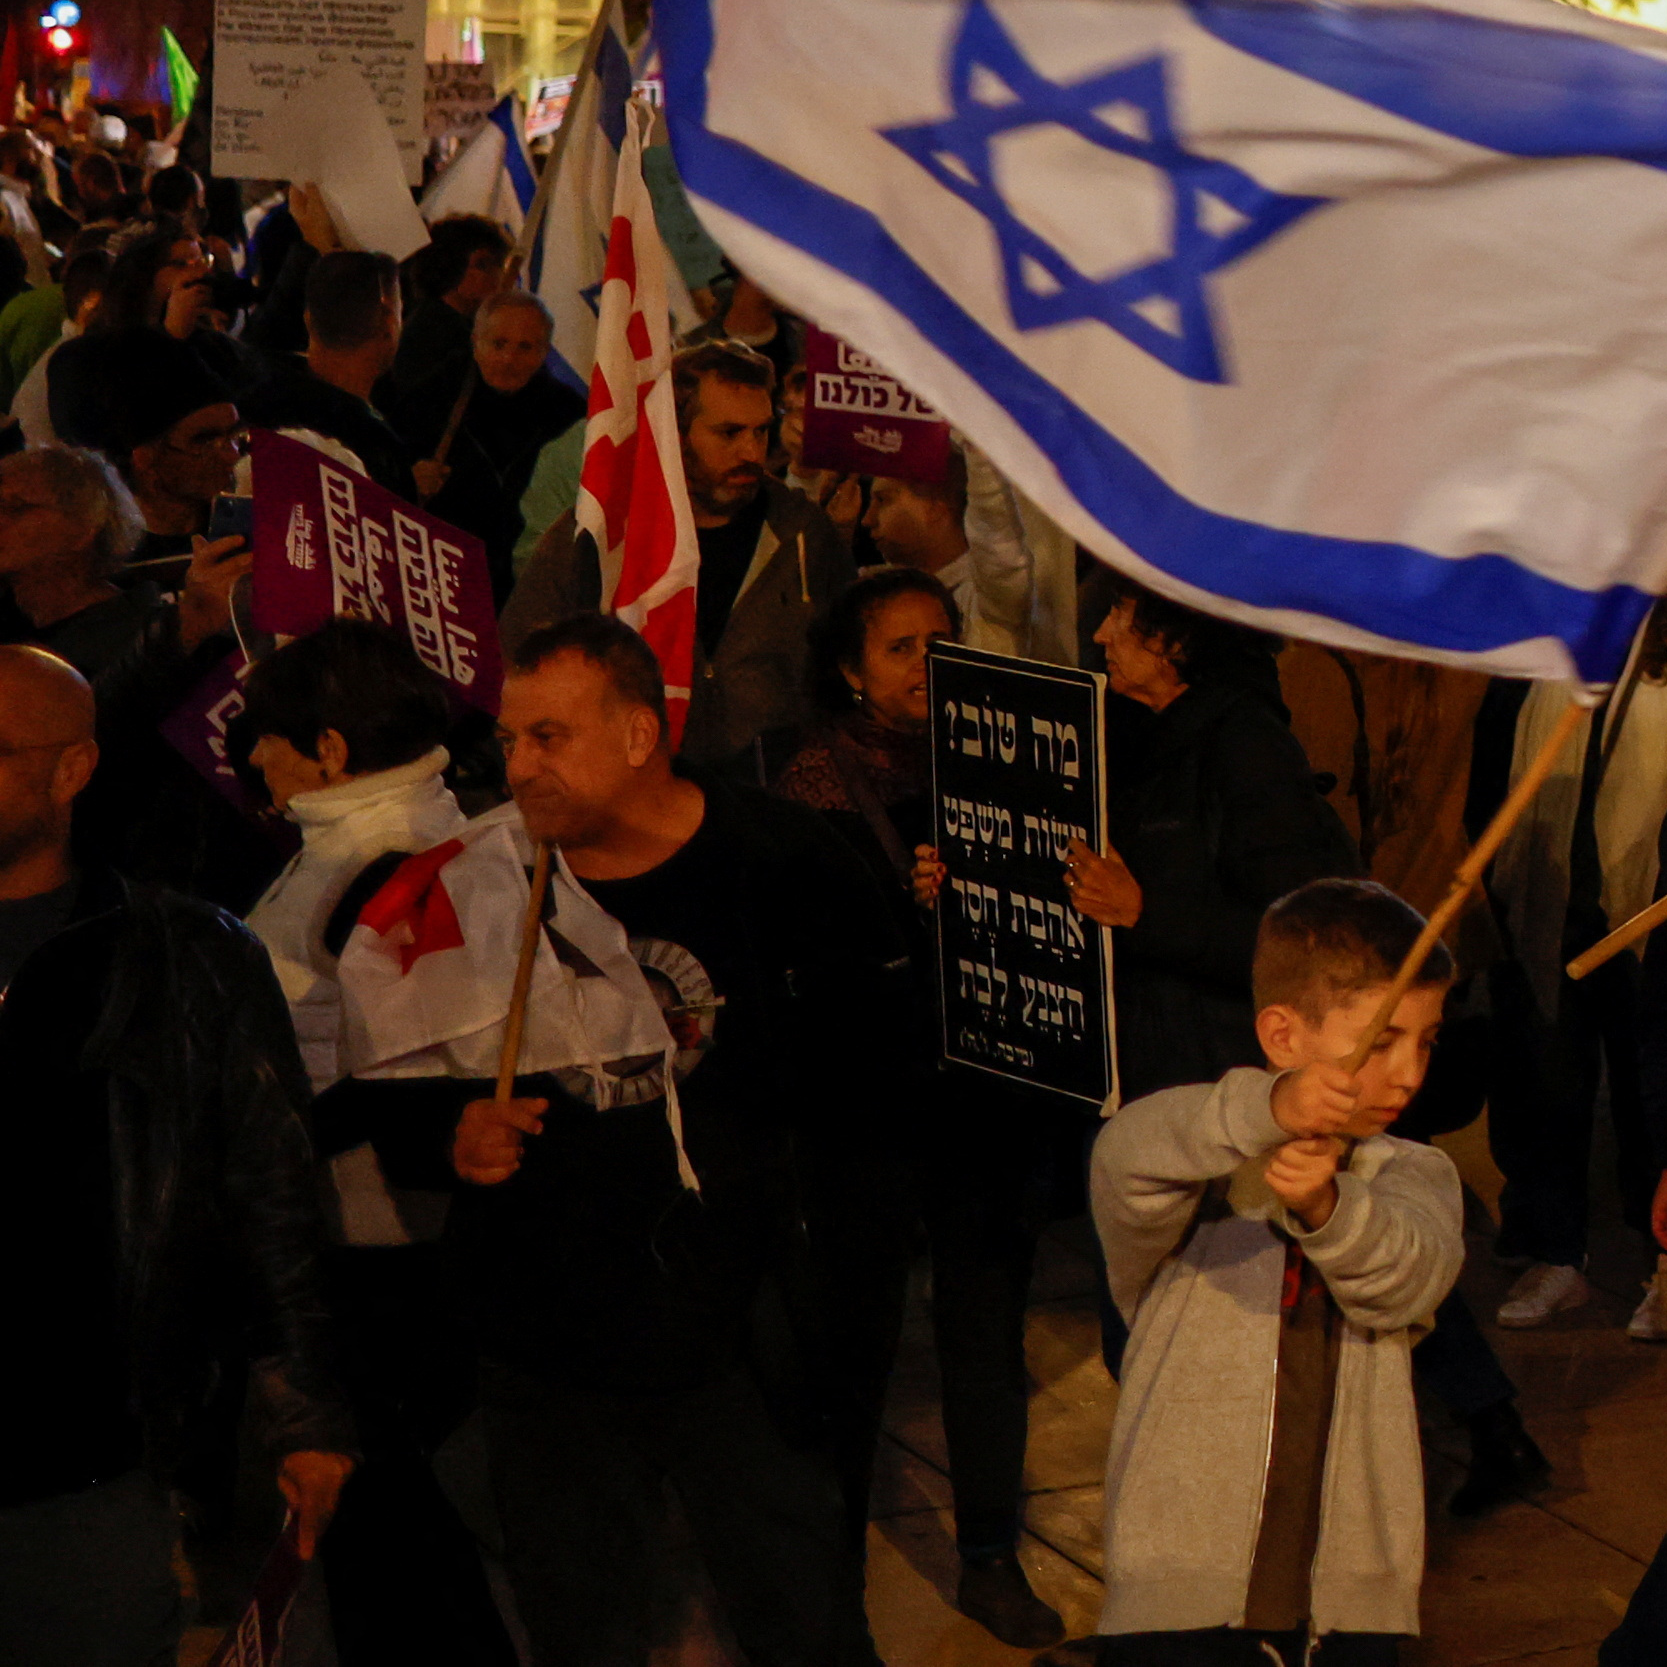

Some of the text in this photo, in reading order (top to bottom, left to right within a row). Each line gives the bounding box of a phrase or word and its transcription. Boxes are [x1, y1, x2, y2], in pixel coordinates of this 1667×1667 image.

[820, 378, 889, 408] כולנו
[399, 519, 441, 670] זה הבית
